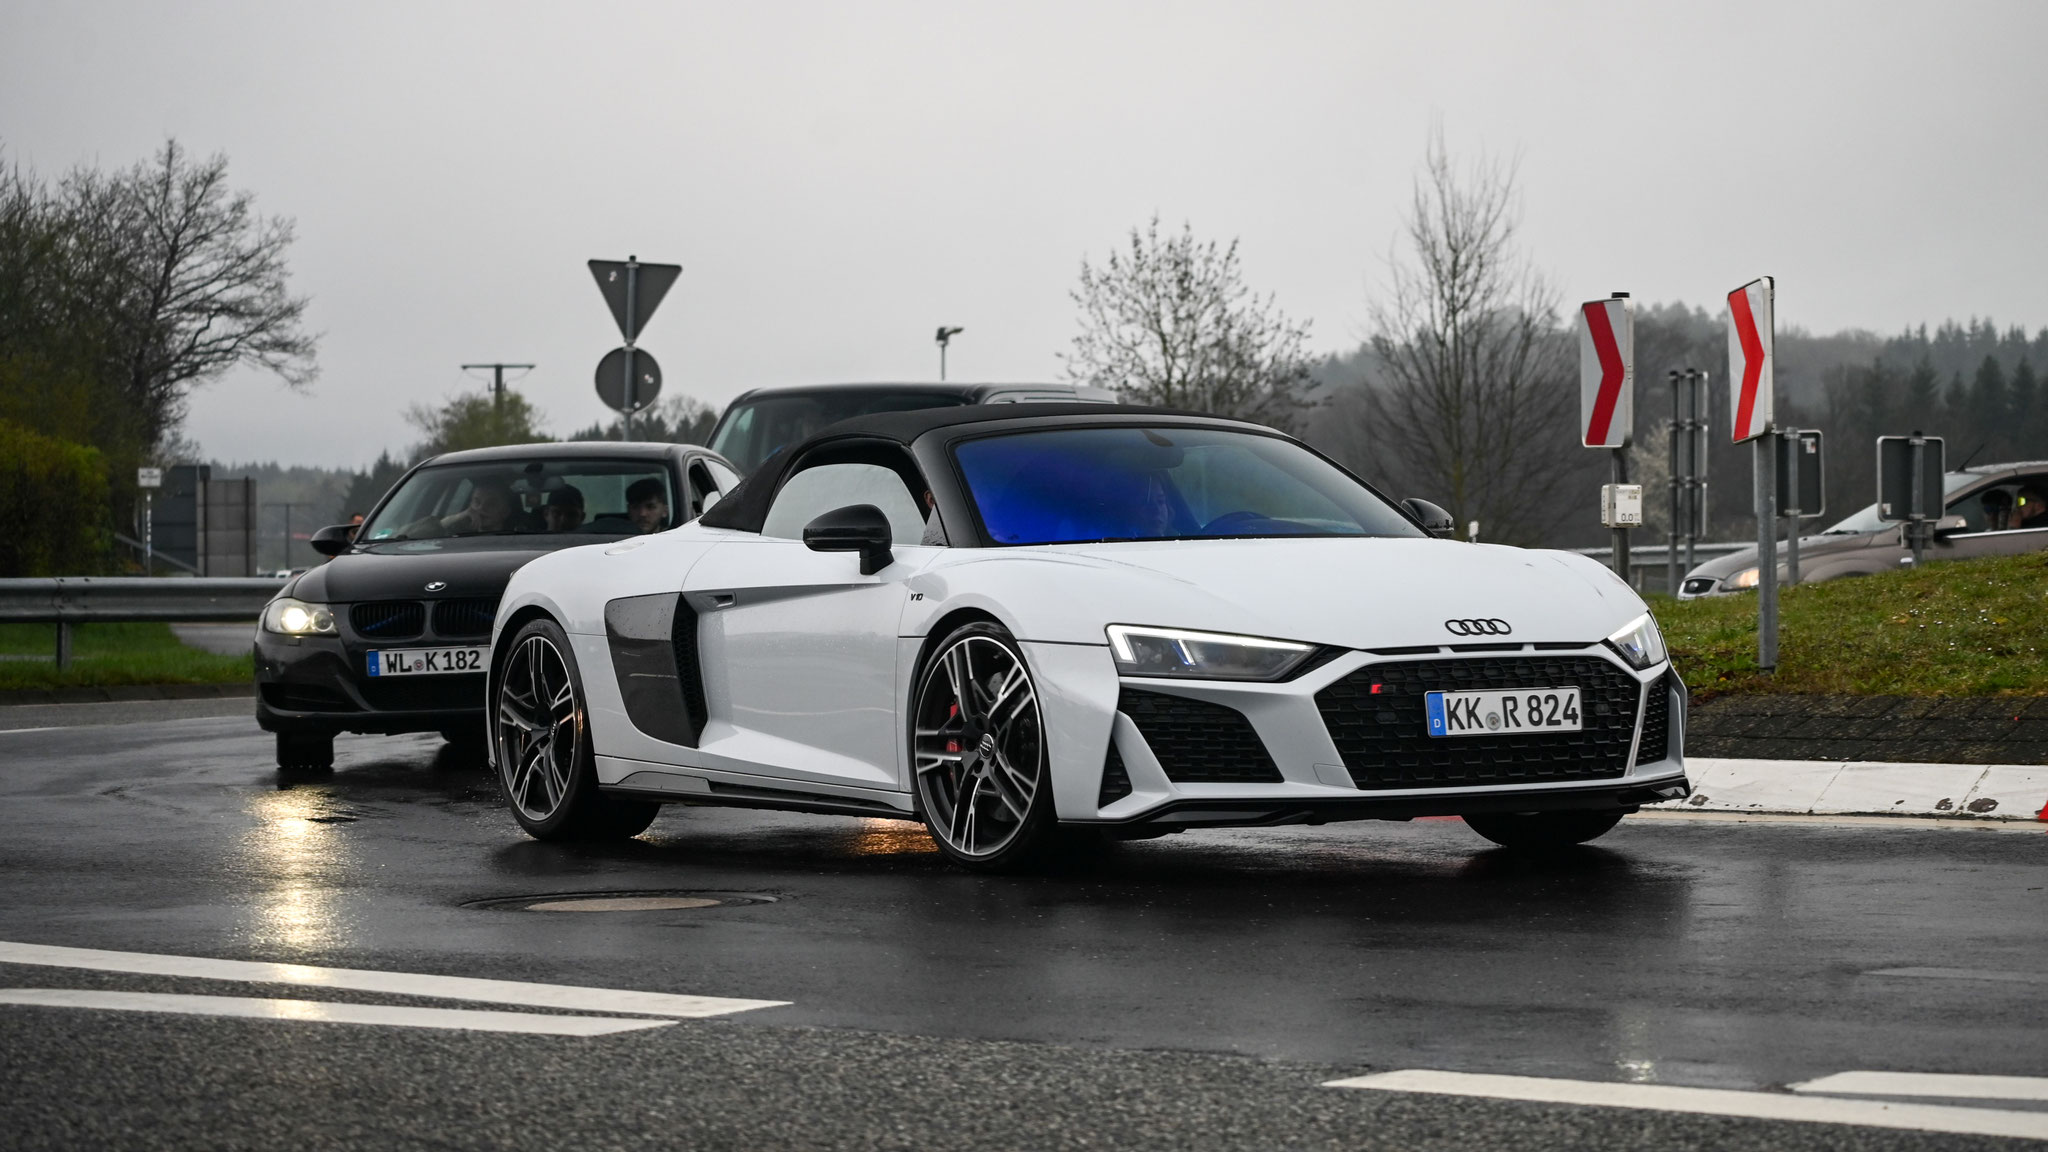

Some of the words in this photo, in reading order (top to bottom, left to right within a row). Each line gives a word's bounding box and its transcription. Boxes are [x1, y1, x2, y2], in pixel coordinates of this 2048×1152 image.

[910, 593, 924, 601] V10
[385, 653, 412, 673] WL
[425, 651, 438, 671] K
[443, 650, 481, 671] 182
[1446, 697, 1484, 730] KK
[1502, 696, 1522, 728] R
[1527, 693, 1579, 726] 824
[1433, 718, 1441, 728] D
